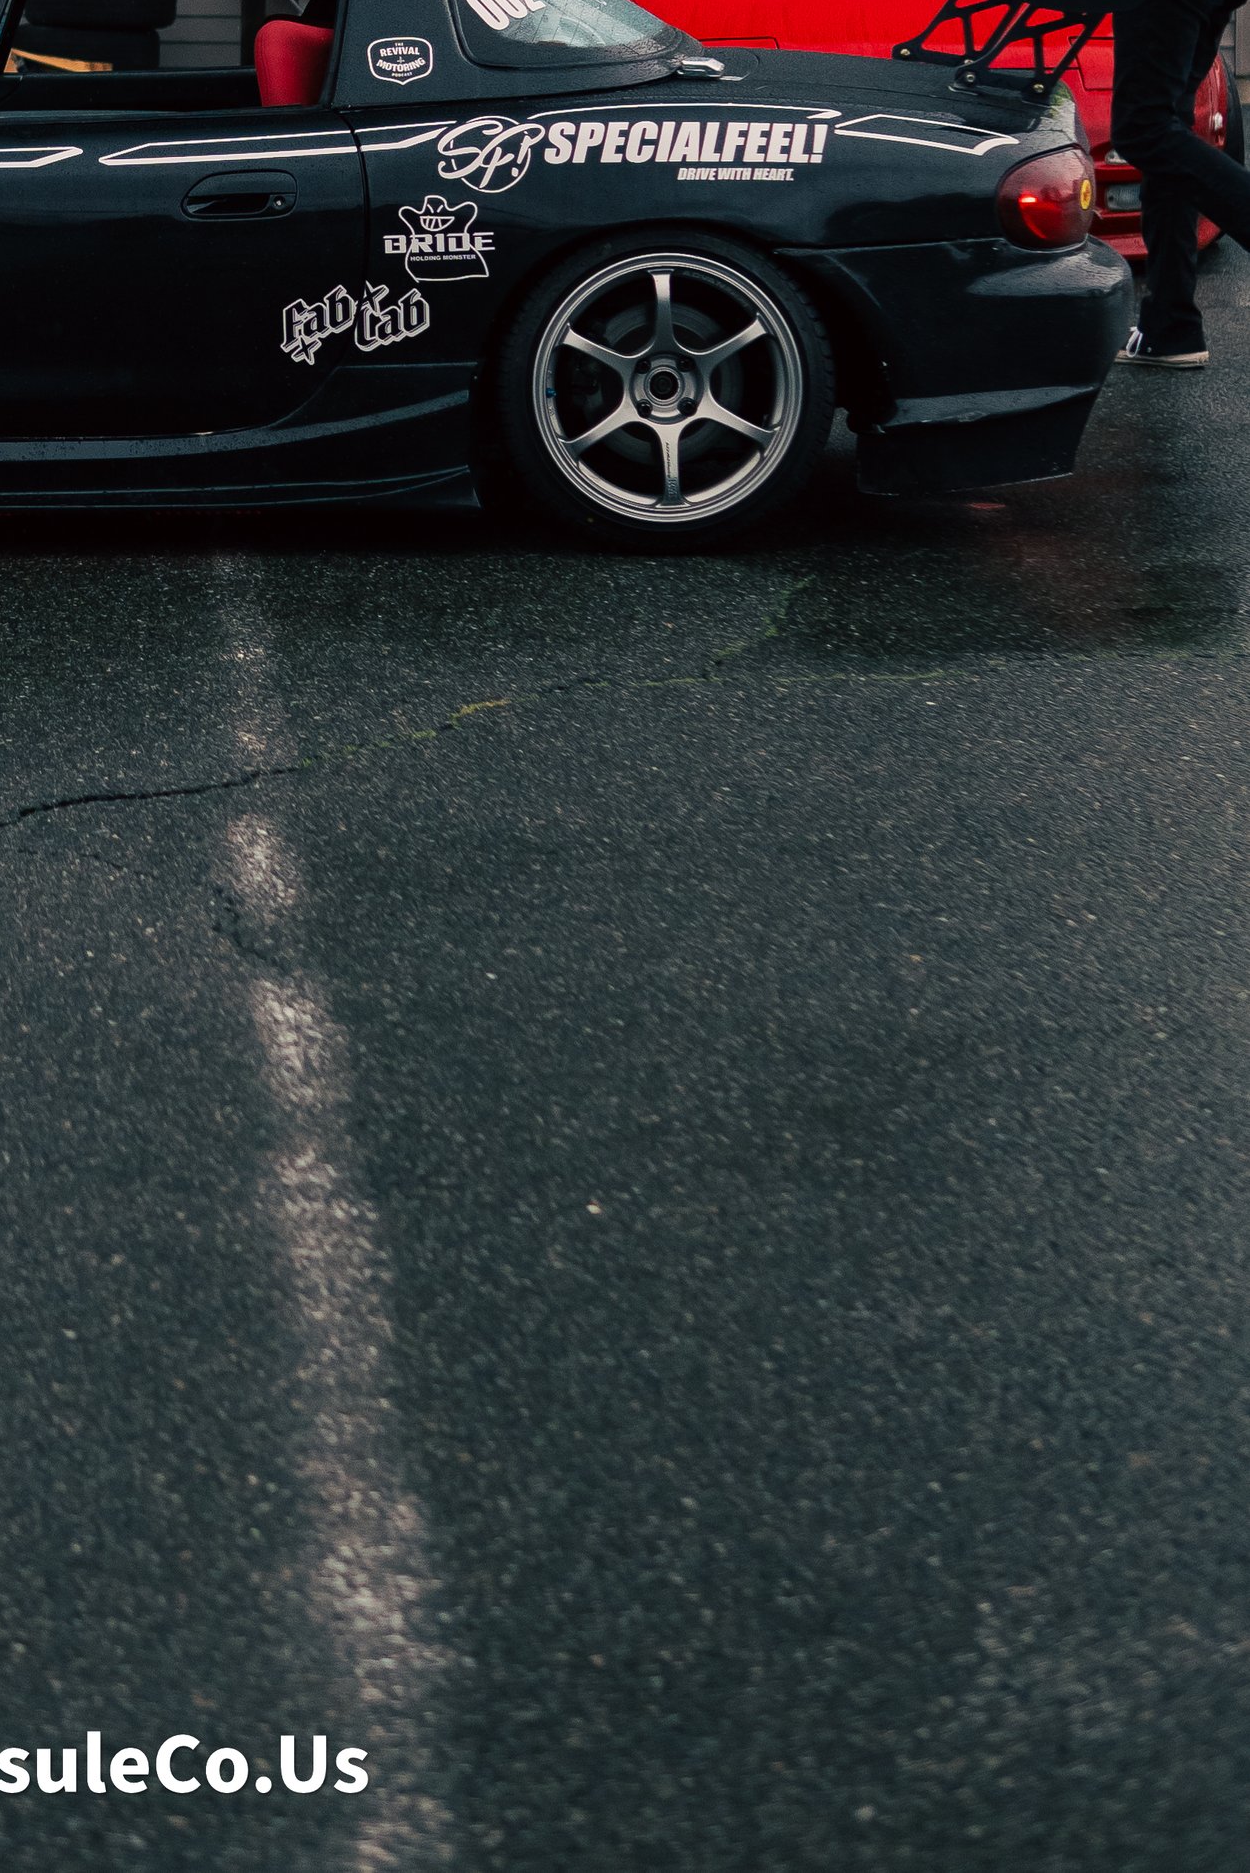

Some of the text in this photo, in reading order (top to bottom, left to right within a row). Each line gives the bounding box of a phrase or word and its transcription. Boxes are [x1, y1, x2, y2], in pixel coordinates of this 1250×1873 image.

[379, 47, 420, 57] REVIVAL
[376, 57, 426, 72] MOTORING
[544, 121, 829, 164] SPECIALFEEL!
[677, 167, 795, 181] DRIVE WITH HEART.
[383, 231, 496, 254] BRIDE
[442, 253, 477, 261] MONSTER
